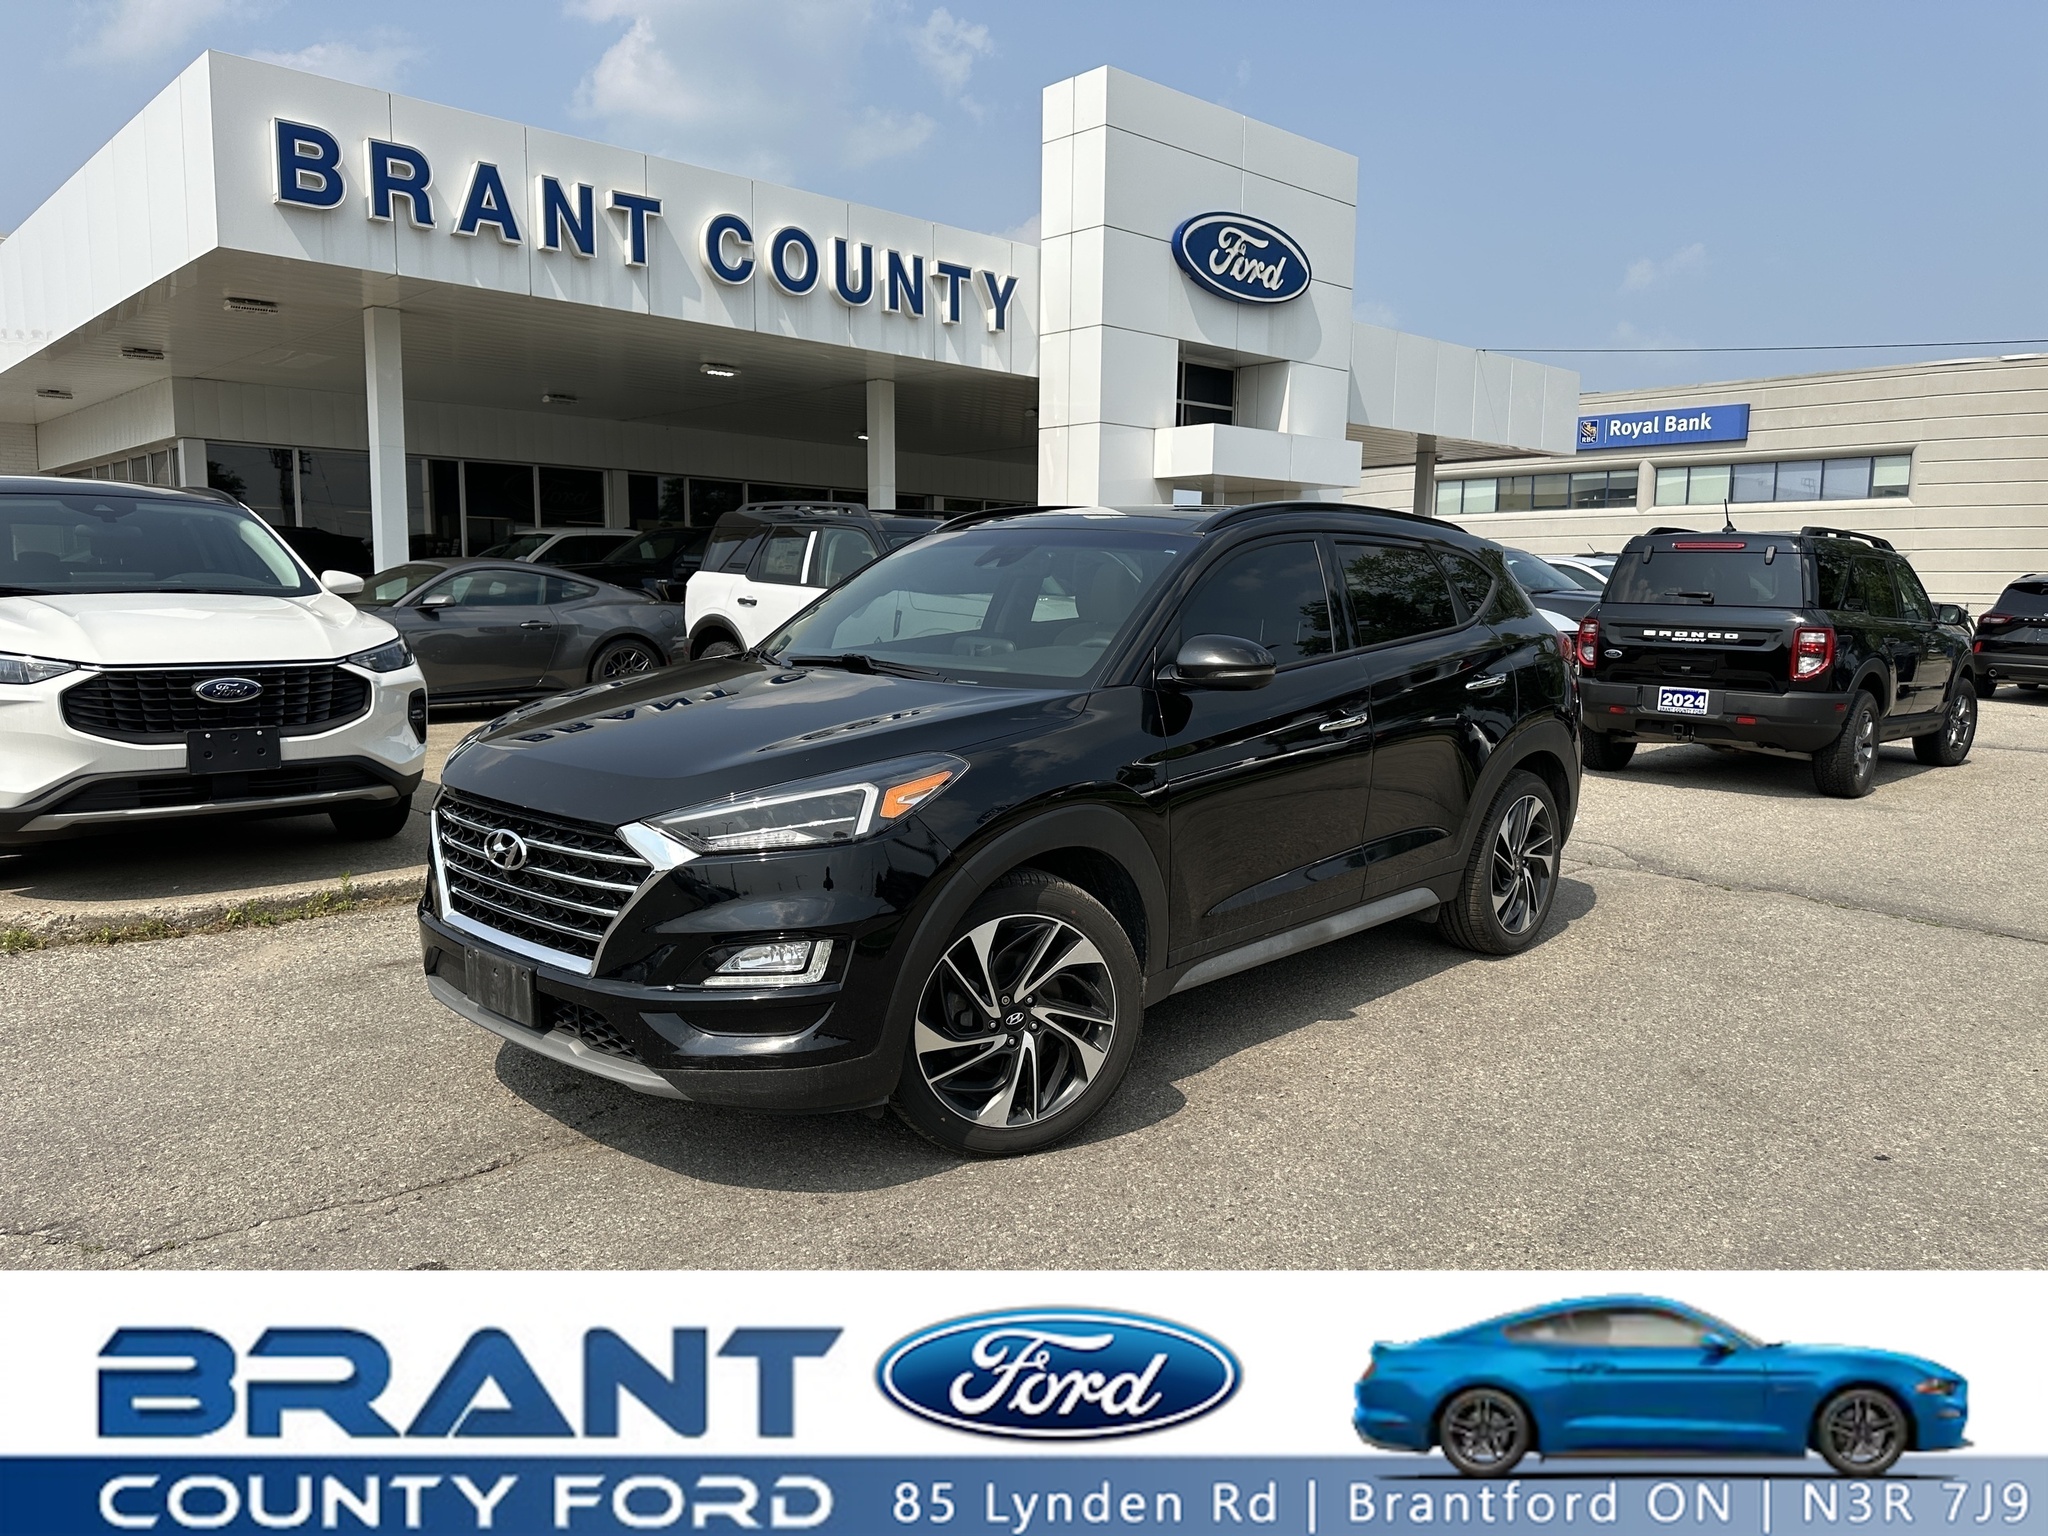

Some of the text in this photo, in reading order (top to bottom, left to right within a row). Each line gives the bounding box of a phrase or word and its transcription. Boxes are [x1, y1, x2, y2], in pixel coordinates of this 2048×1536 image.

[270, 117, 1020, 333] BRANT COUNTY
[1208, 226, 1287, 291] Ford
[1609, 412, 1712, 439] Royal Bank
[1643, 630, 1739, 639] BRONCO
[212, 683, 248, 697] Ford
[1661, 692, 1705, 709] 2024
